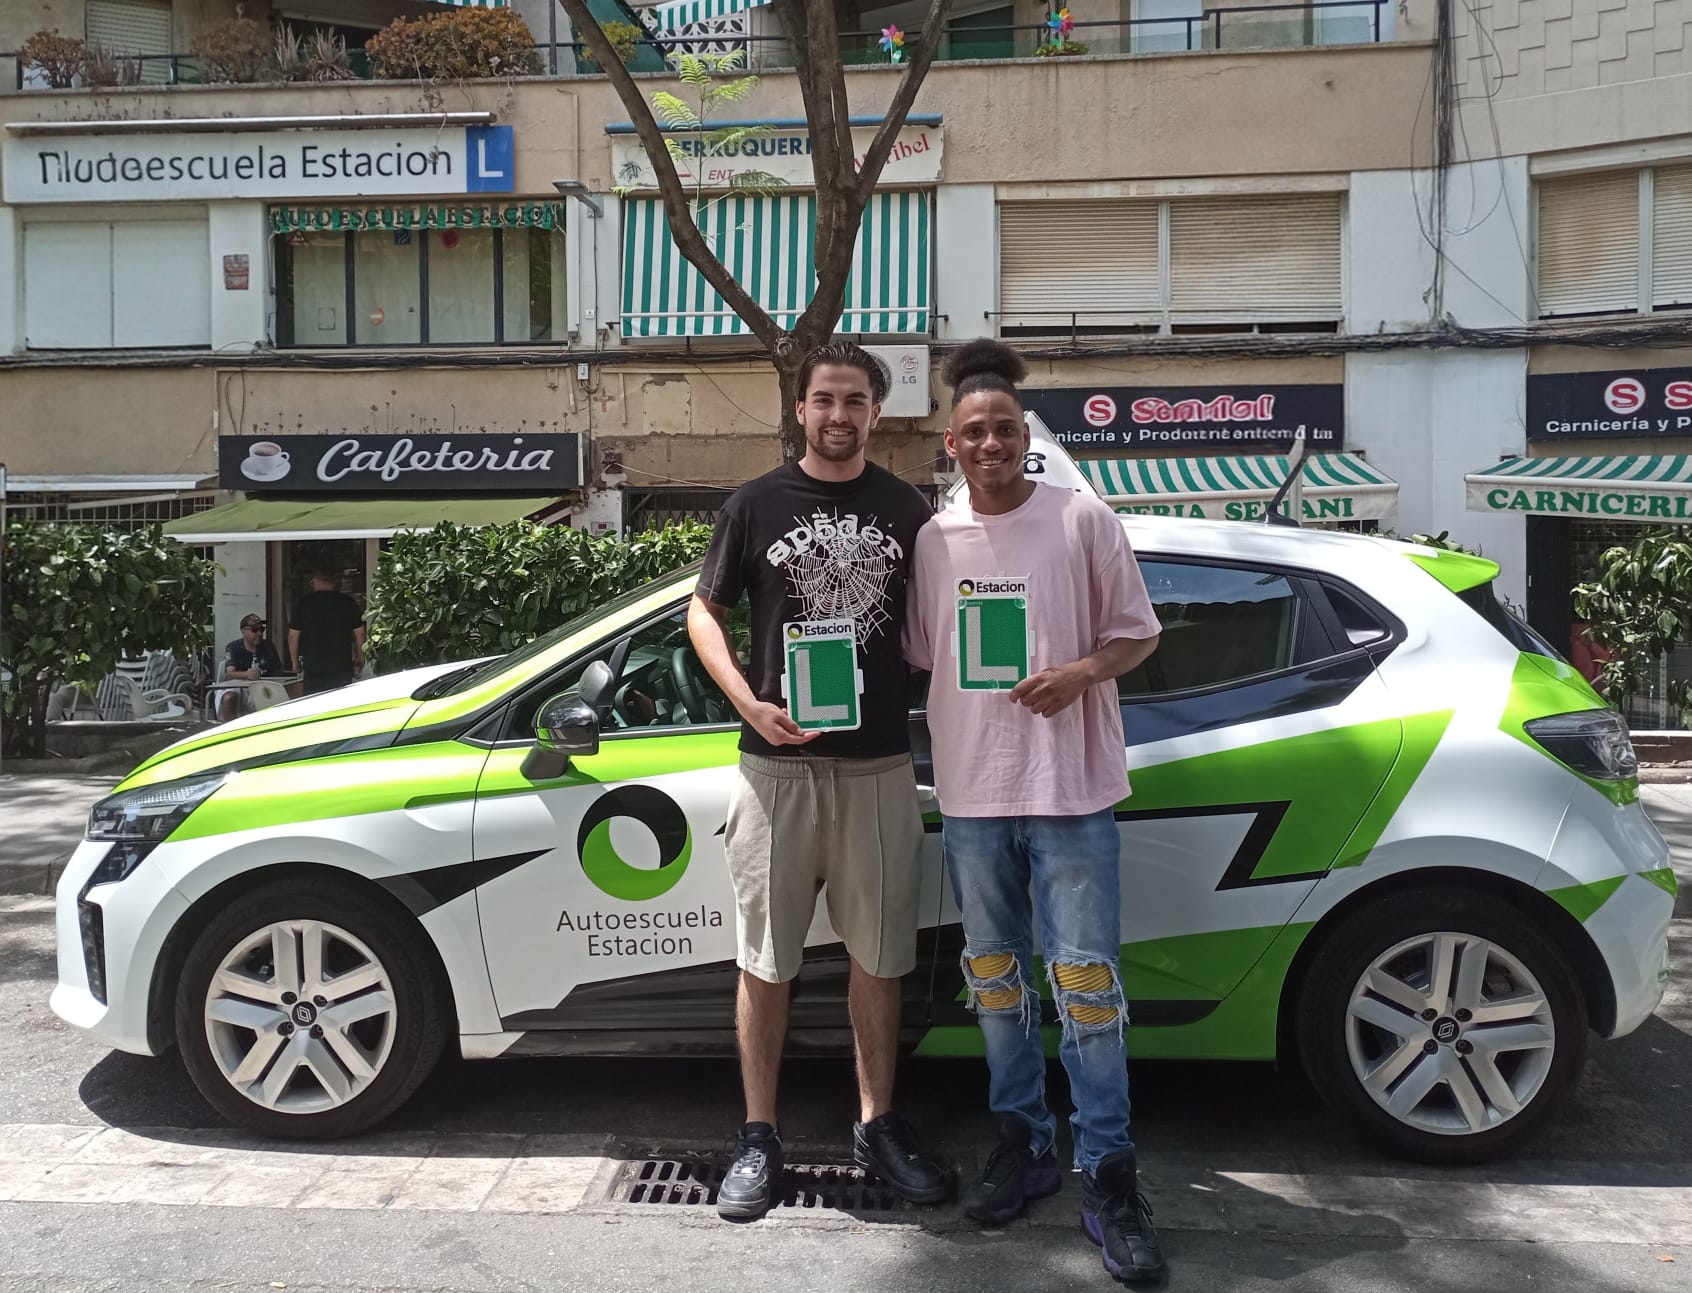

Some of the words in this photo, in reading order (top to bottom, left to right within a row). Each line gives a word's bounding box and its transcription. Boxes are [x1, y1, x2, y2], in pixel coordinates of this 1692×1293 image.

[301, 142, 452, 178] Estacion
[478, 138, 504, 178] L
[902, 375, 917, 385] LG
[1610, 383, 1639, 408] S
[1088, 399, 1111, 422] S
[1546, 416, 1649, 433] Carnicería
[1657, 419, 1669, 431] y
[1122, 431, 1134, 444] y
[316, 438, 554, 482] Cafeteria
[976, 581, 1026, 593] Estacion
[804, 622, 852, 636] Estacion
[965, 606, 1019, 682] L
[794, 649, 849, 722] L
[556, 905, 723, 932] Autoescuela
[588, 932, 693, 957] Estacion
